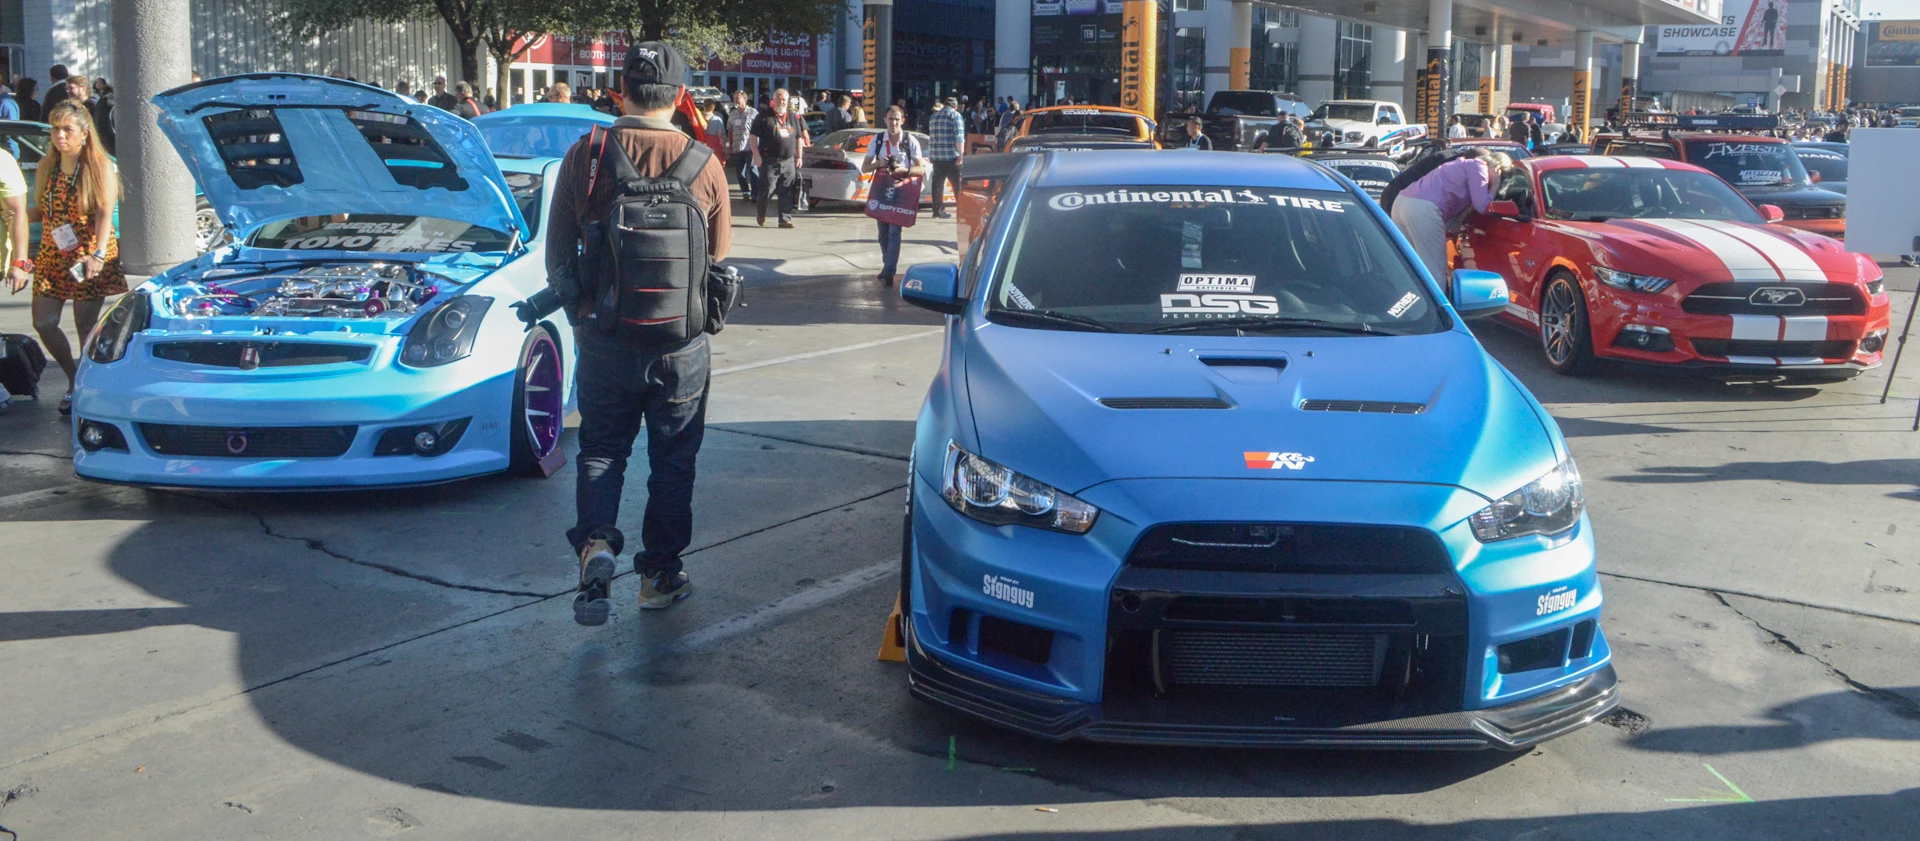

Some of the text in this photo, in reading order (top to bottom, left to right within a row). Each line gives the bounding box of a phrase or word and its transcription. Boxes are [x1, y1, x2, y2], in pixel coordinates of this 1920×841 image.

[1083, 29, 1095, 39] TEN
[1662, 27, 1738, 39] SHOWCASE
[1883, 25, 1920, 38] Contin
[612, 51, 627, 61] 203
[639, 48, 658, 60] TMT
[1704, 144, 1787, 160] HYBRID
[1049, 190, 1345, 213] Continental TIRE
[878, 203, 916, 216] SPYDER
[324, 222, 405, 231] ENERGY
[283, 235, 477, 252] TOYO TIRES
[1184, 276, 1249, 286] OPTIMA
[1160, 294, 1279, 315] DSG
[1387, 291, 1417, 318] MOTHERS
[983, 574, 1035, 609] Signguy
[1536, 588, 1577, 616] Signguy
